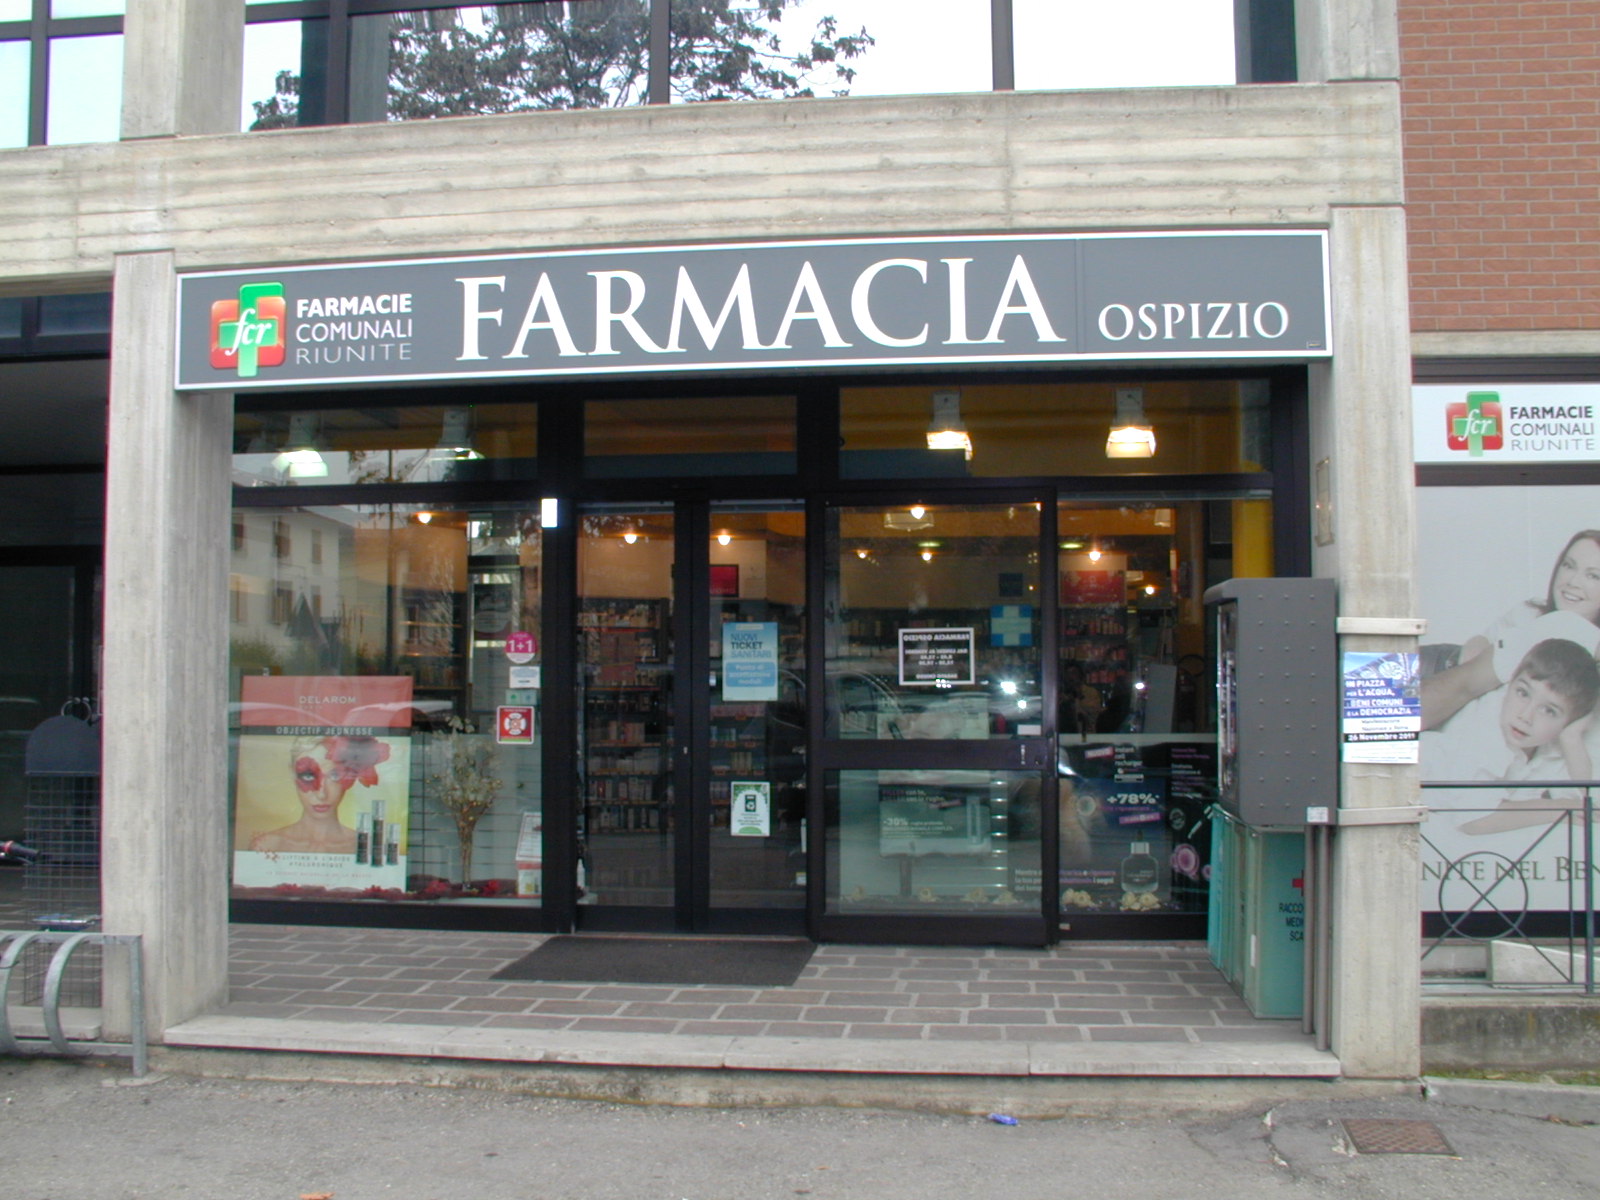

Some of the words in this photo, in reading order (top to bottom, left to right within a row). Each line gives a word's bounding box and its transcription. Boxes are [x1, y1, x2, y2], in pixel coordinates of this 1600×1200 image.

[296, 293, 413, 319] FARMACIE
[454, 254, 1067, 362] FARMACIA
[1097, 301, 1290, 342] OSPIZIO
[224, 308, 272, 356] fcr
[296, 318, 413, 344] COMUNALI
[296, 343, 412, 365] RIUNITE
[1510, 406, 1593, 419] FARMACIE
[1458, 408, 1493, 441] fcr
[1510, 422, 1594, 436] COMUNALI
[1511, 439, 1596, 451] RIUNITE
[730, 633, 758, 641] NUOVI
[731, 641, 763, 649] TICKET
[731, 650, 772, 658] SANITARI
[1356, 680, 1386, 688] PIAZZA
[299, 695, 357, 704] DELAROM
[1372, 699, 1403, 707] COMUNI
[1360, 707, 1412, 716] DEMOCRAZIA
[276, 727, 321, 735] OBJECTIF
[325, 727, 373, 736] JEUNESSE
[1359, 733, 1398, 741] Novembre
[1495, 861, 1545, 881] NEL
